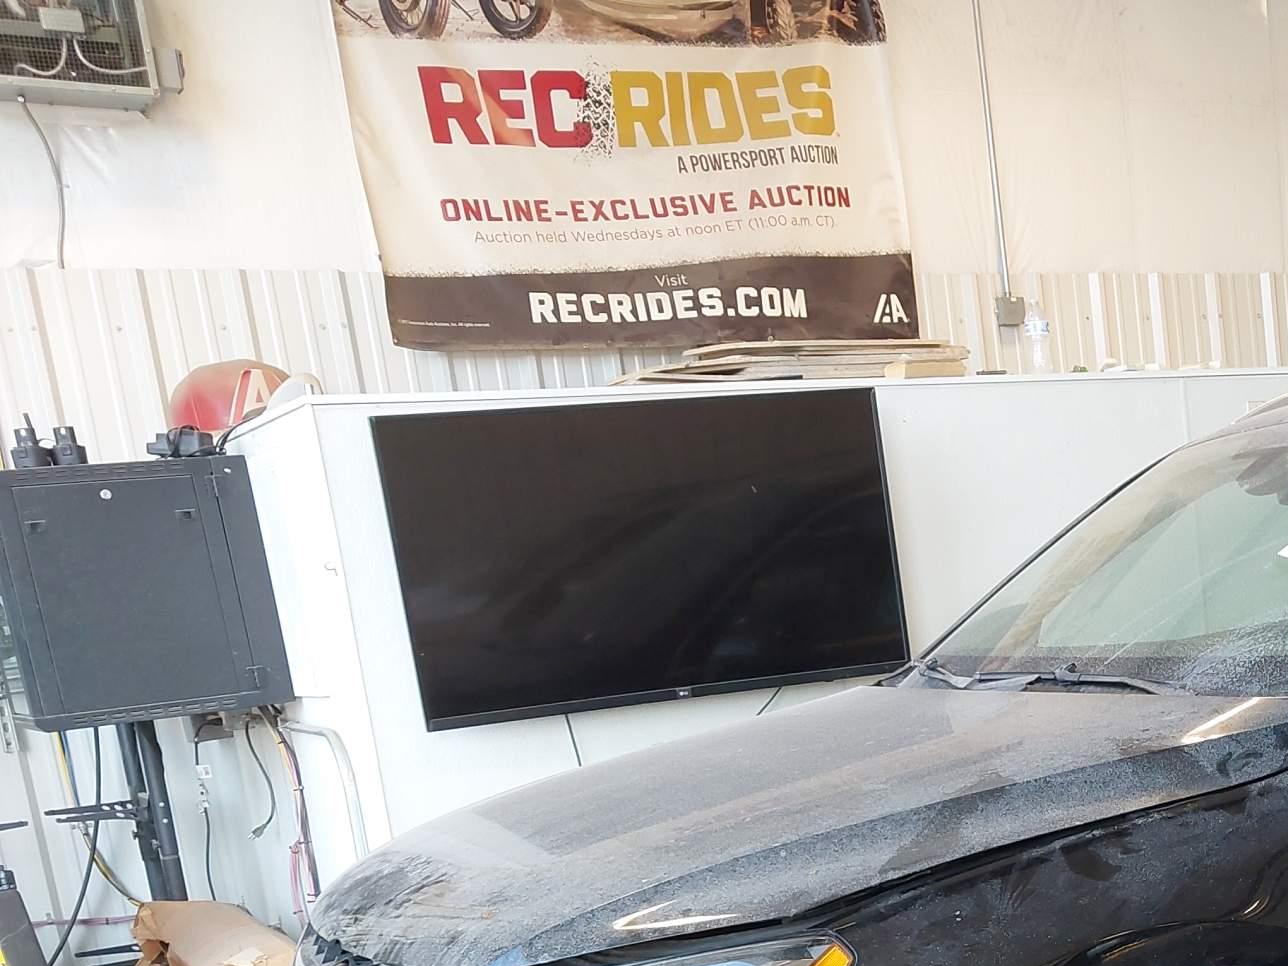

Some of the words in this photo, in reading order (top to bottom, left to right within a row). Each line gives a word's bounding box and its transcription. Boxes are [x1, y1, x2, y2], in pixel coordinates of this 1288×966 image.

[416, 65, 594, 149] REC
[609, 64, 837, 148] RIDES
[677, 155, 689, 175] A
[690, 147, 786, 174] POWERSPORT
[790, 144, 839, 165] AUCTION
[439, 191, 738, 223] ONLINE-EXCLUSIVE
[749, 184, 852, 210] AUCTION
[474, 230, 532, 245] Auction
[535, 230, 568, 244] held
[570, 227, 663, 244] Wednesdays
[667, 226, 682, 238] at
[686, 224, 722, 237] noon
[725, 219, 743, 233] ET
[748, 214, 788, 231] (11:00
[655, 273, 689, 288] Visit
[528, 287, 808, 324] RECRIDES.COM
